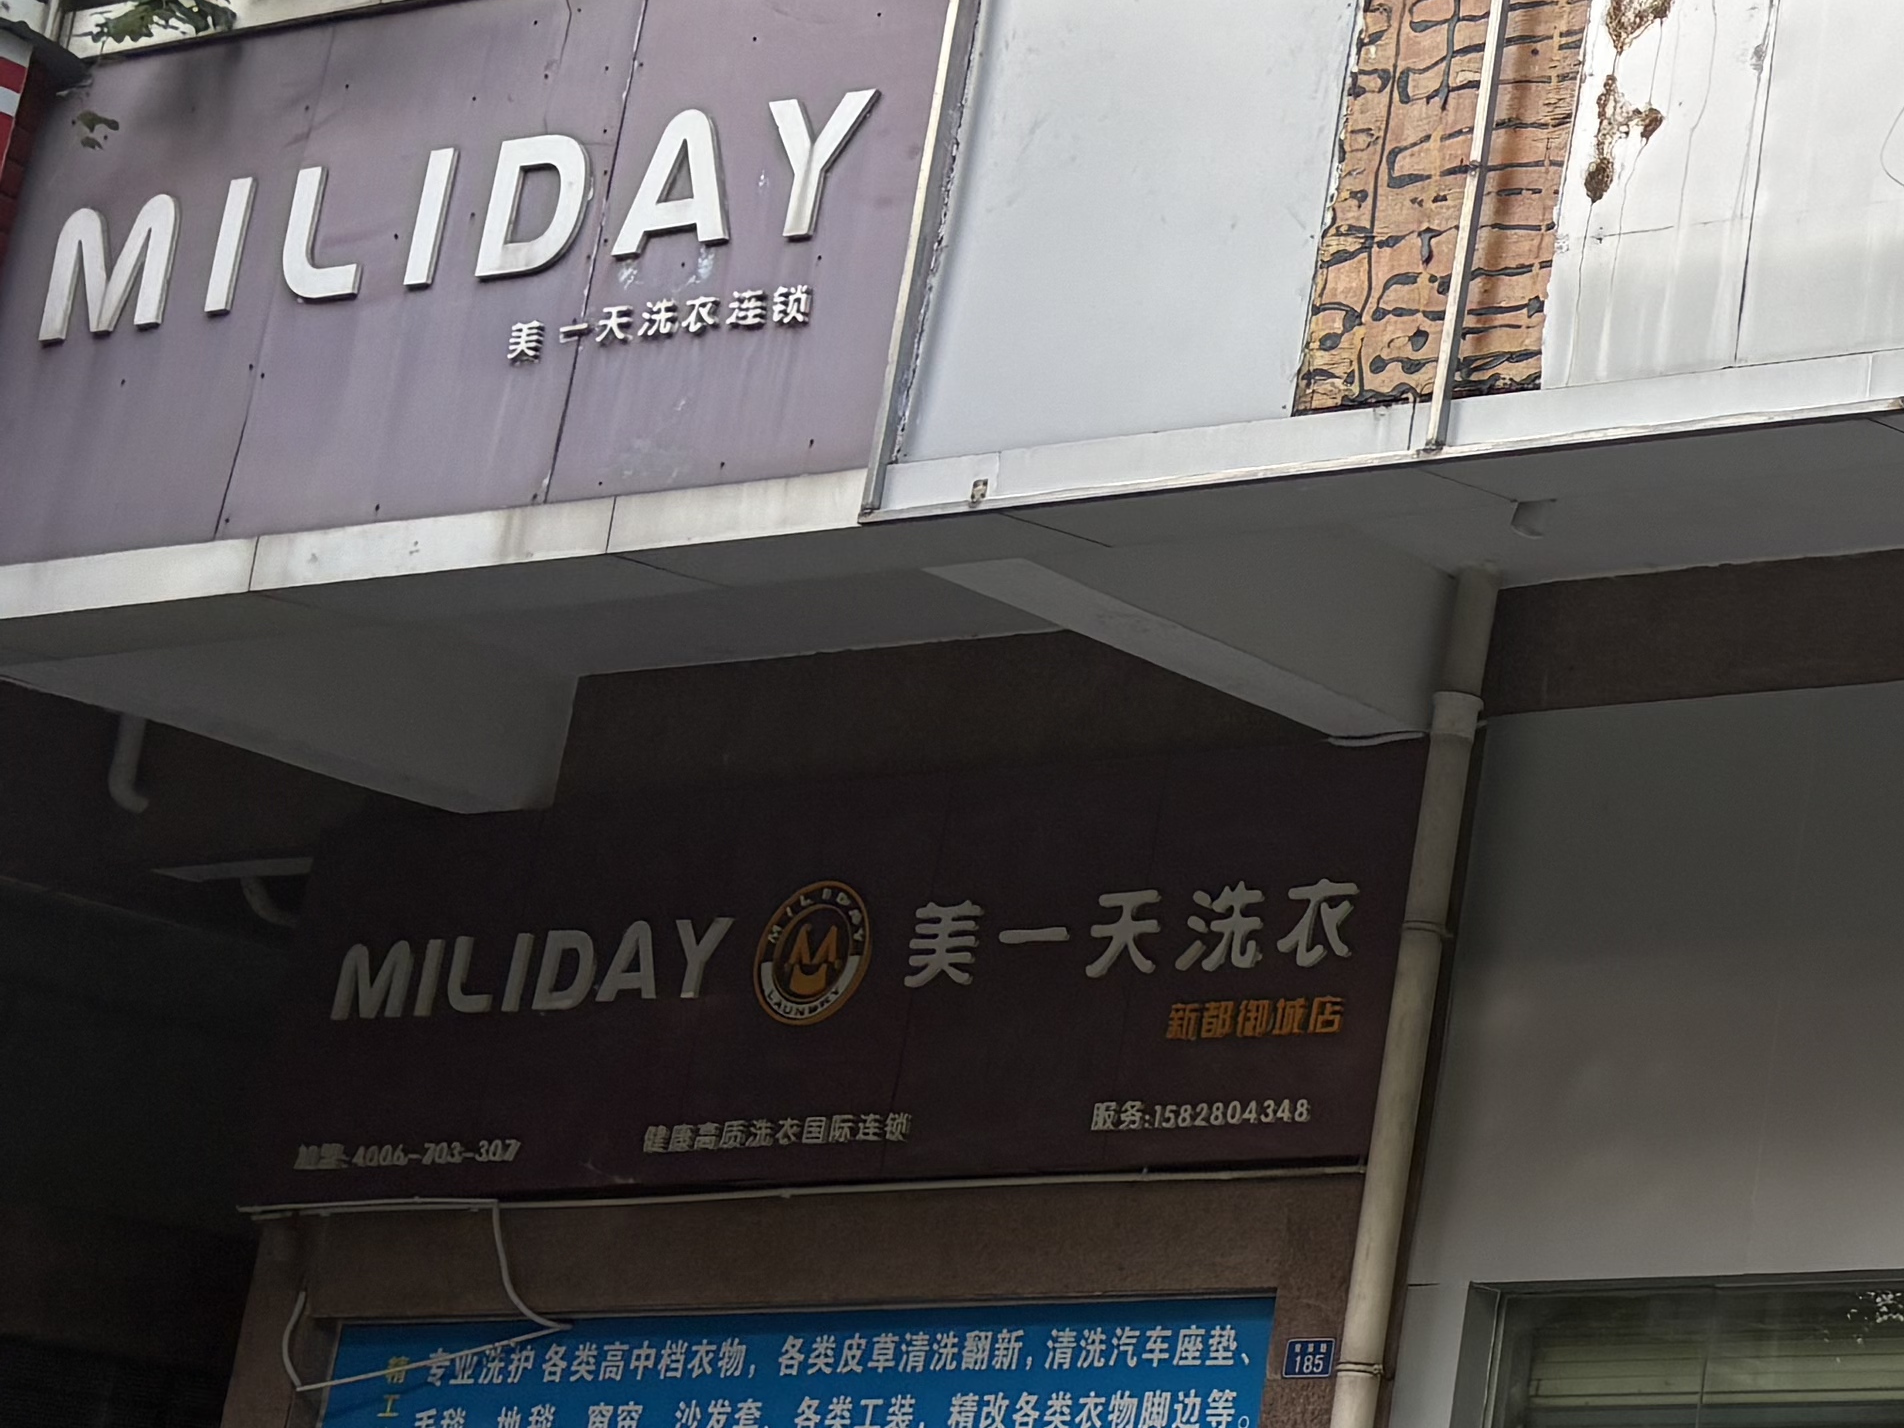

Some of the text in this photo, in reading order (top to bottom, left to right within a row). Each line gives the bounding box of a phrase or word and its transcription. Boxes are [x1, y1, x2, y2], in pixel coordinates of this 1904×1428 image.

[38, 88, 882, 345] MILIDAY
[506, 284, 814, 363] 美一天洗衣连锁
[330, 916, 736, 1021] MILIDAY
[904, 878, 1360, 989] 美一天洗衣
[1166, 995, 1345, 1041] 新都御城店
[643, 1111, 912, 1153] 健康高质洗衣国际连锁
[1294, 1354, 1326, 1374] 185
